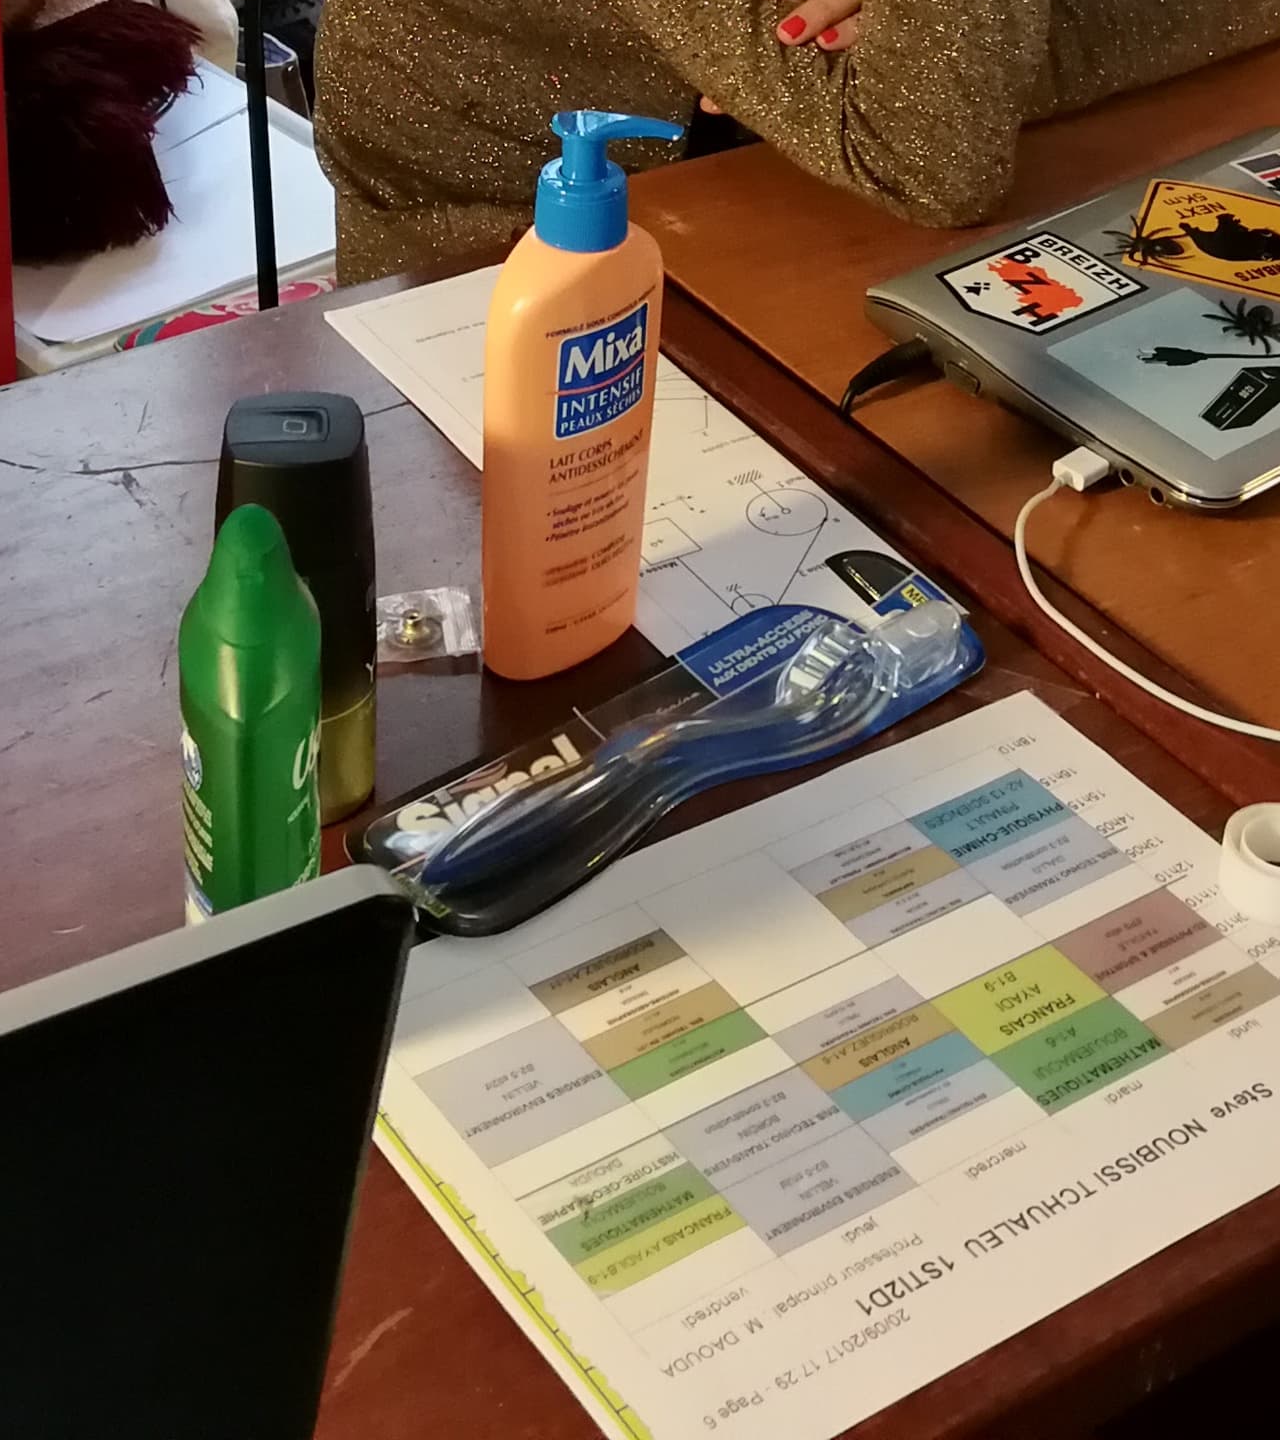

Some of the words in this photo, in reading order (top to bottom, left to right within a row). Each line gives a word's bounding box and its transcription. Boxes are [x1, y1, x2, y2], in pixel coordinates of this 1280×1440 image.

[1174, 201, 1229, 220] NEXT
[1037, 237, 1132, 291] BREIZH
[564, 326, 644, 385] Mixa
[561, 365, 644, 419] INTENSIF
[559, 412, 604, 435] PEAUX
[549, 452, 574, 471] LAIT
[578, 437, 613, 462] CORPS
[708, 609, 815, 675] ULTRA-ACCESS
[712, 665, 741, 688] AUX
[737, 645, 778, 675] DENTS
[775, 632, 797, 651] DU
[995, 730, 1039, 758] 18h10
[1036, 763, 1080, 790] 16h15
[920, 790, 992, 832] SCIENCES
[1064, 786, 1108, 813] 15h15
[947, 795, 1065, 863] PHYSIQUE-CHIMIE
[1092, 809, 1137, 836] 14h05
[1121, 833, 1166, 860] 13h05
[1151, 857, 1197, 885] 12h10
[584, 959, 643, 996] ANGLAIS
[991, 980, 1045, 1013] AYADI
[995, 990, 1077, 1038] FRANCAIS
[1225, 1016, 1264, 1041] lundi
[855, 1034, 913, 1069] ANGLAIS
[1033, 1035, 1162, 1107] MATHEMATIQUES
[543, 1065, 604, 1104] ENERGIES
[1100, 1077, 1148, 1107] mardi
[1205, 1080, 1276, 1123] Steve
[961, 1139, 1031, 1181] mercredi
[1090, 1116, 1212, 1188] NOUBISSI
[841, 1164, 902, 1200] ENERGIES
[577, 1186, 696, 1256] MATHEMATIQUES
[660, 1204, 732, 1247] FRANCAIS
[836, 1215, 883, 1246] jeudi
[959, 1177, 1101, 1259] TCHUALEU
[836, 1230, 925, 1283] Professeur
[767, 1271, 843, 1319] principal
[851, 1251, 960, 1317] 1STI2D1
[677, 1285, 750, 1330] vendredi
[656, 1329, 742, 1381] DAOUDA
[818, 1306, 915, 1365] 20/09/2017
[699, 1412, 719, 1431] 6
[713, 1386, 767, 1423] Page
